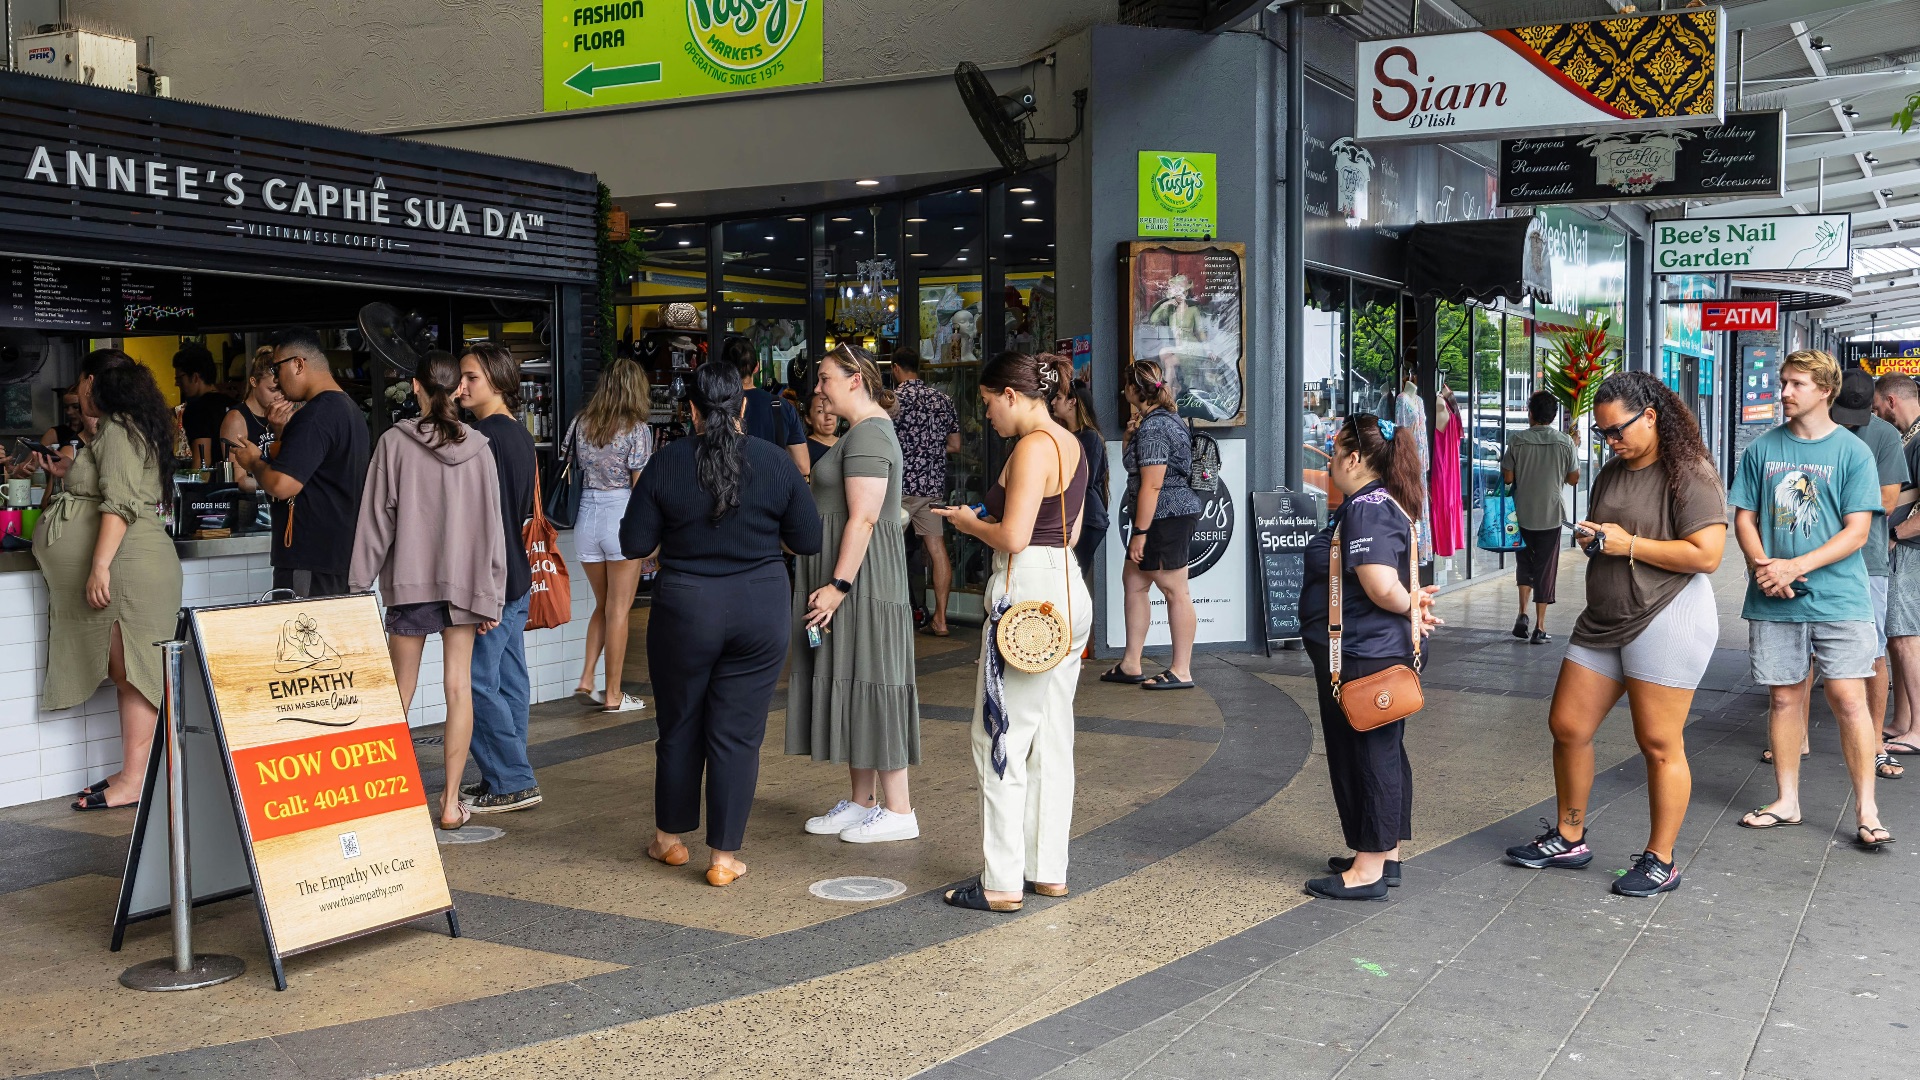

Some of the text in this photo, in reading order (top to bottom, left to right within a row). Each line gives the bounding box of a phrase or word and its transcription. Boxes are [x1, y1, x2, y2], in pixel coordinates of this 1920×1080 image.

[574, 0, 643, 26] FASHION
[574, 29, 625, 52] FLORA
[707, 34, 763, 60] MARKETS
[29, 52, 50, 60] PAK
[684, 41, 785, 85] OPERATING SINCE 1975
[1372, 45, 1508, 121] Siam
[1703, 126, 1756, 142] Clothing
[1511, 138, 1565, 155] Gorgeous
[1511, 159, 1570, 174] Romantic
[1701, 148, 1755, 167] Lingerie
[1511, 182, 1574, 197] Irresistible
[1701, 173, 1772, 188] Accessories
[24, 146, 246, 206] ANNEE'S
[262, 176, 390, 224] CAPHÊ
[404, 197, 470, 235] SUA
[248, 223, 393, 249] VIETNAMESE COFFEE
[1660, 223, 1776, 245] Bee's Nail
[1659, 248, 1750, 267] Garden
[1724, 307, 1772, 324] ATM
[1851, 346, 1867, 360] the
[1881, 359, 1920, 367] LUCKY
[1799, 463, 1834, 482] COMPANY
[531, 541, 546, 553] All
[268, 671, 354, 699] EMPATHY
[276, 705, 294, 713] THAI
[295, 698, 331, 710] MASSAGE
[255, 738, 397, 785] NOW OPEN
[263, 775, 409, 820] Call: 4041 0272
[296, 858, 415, 896] The Empathy We Care
[318, 882, 404, 912] www.thaiempathy.com
